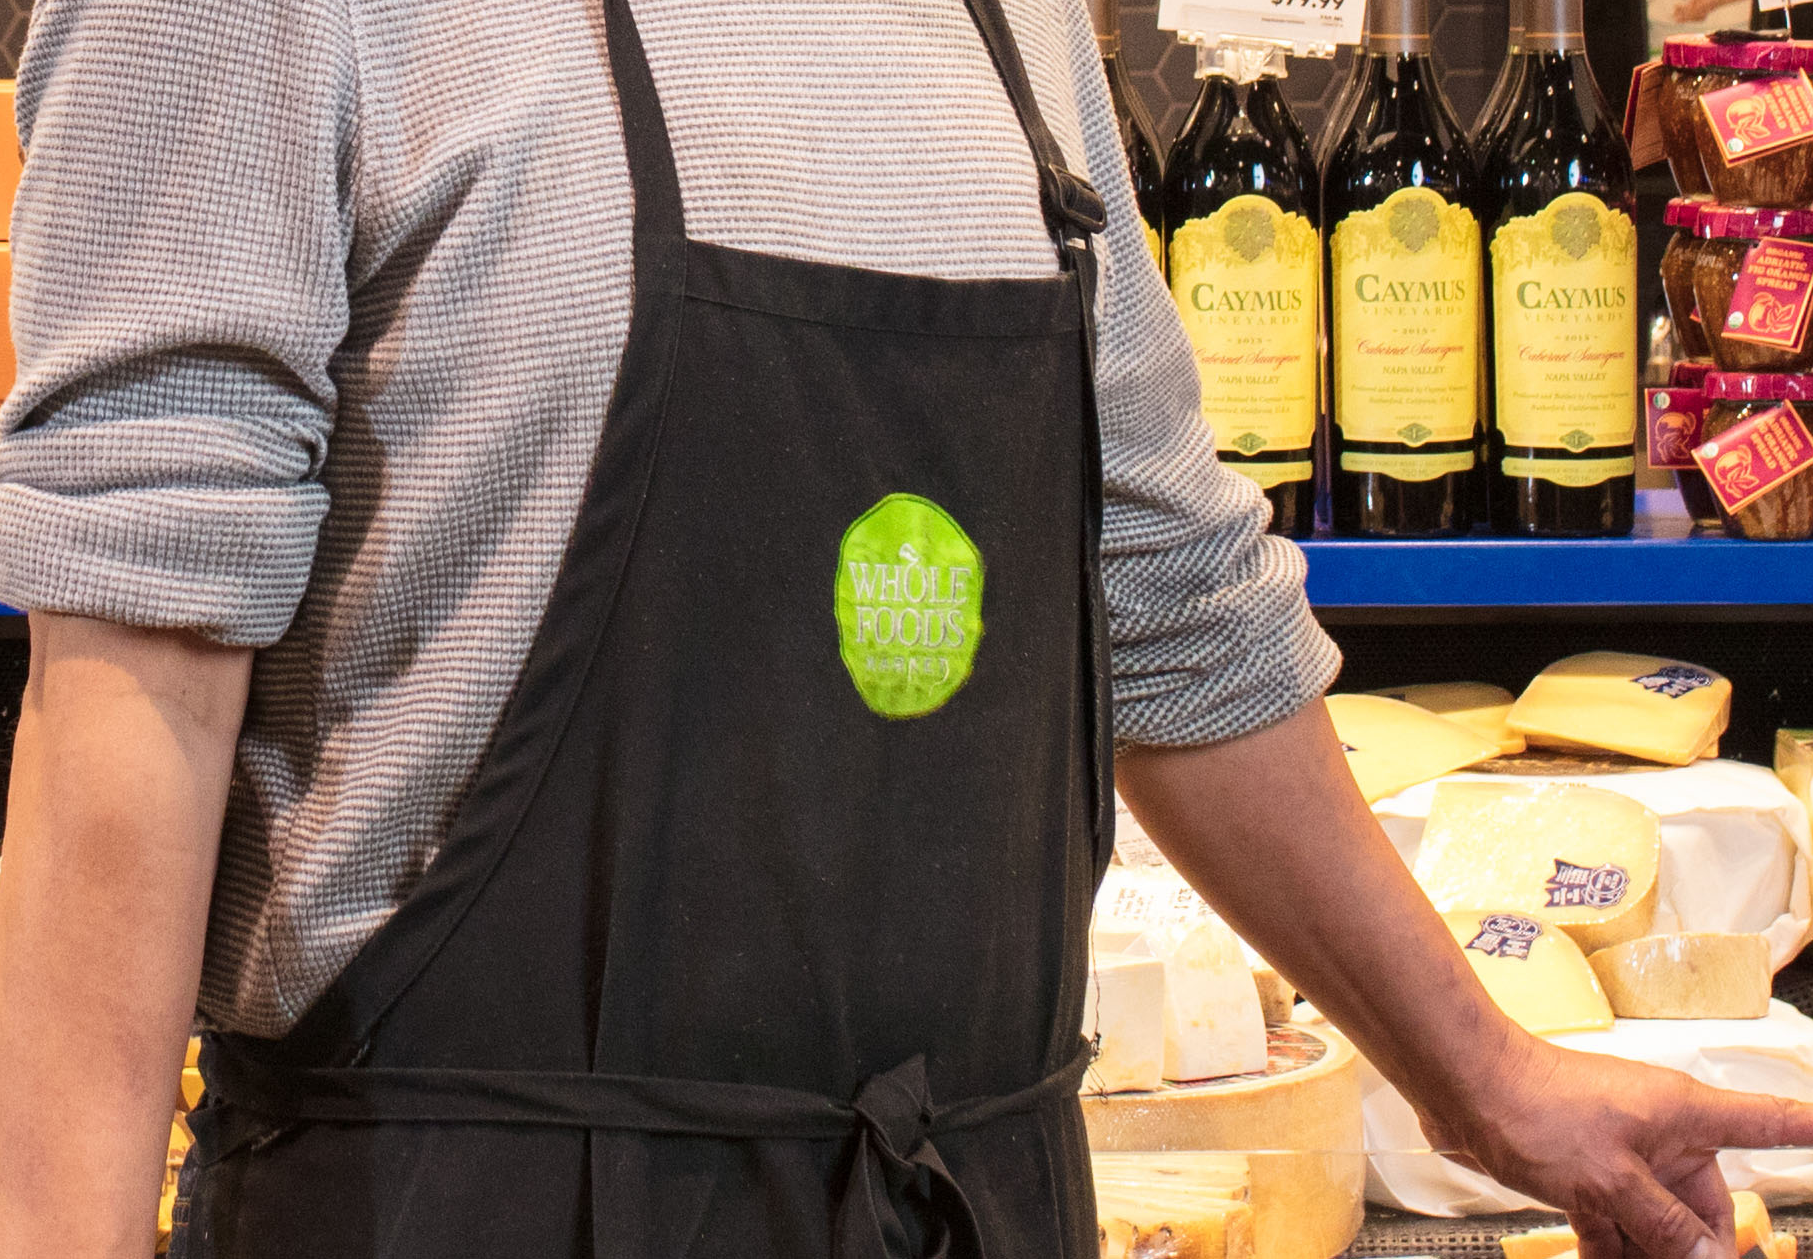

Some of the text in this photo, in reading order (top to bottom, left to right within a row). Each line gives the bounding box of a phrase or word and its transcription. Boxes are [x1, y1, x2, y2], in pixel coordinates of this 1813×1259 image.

[1190, 283, 1302, 312] CAYMUS
[1355, 274, 1466, 304] CAYMUS
[1517, 281, 1626, 309] CAYMUS
[848, 561, 970, 603] WHOLE
[856, 606, 965, 648] FOODS
